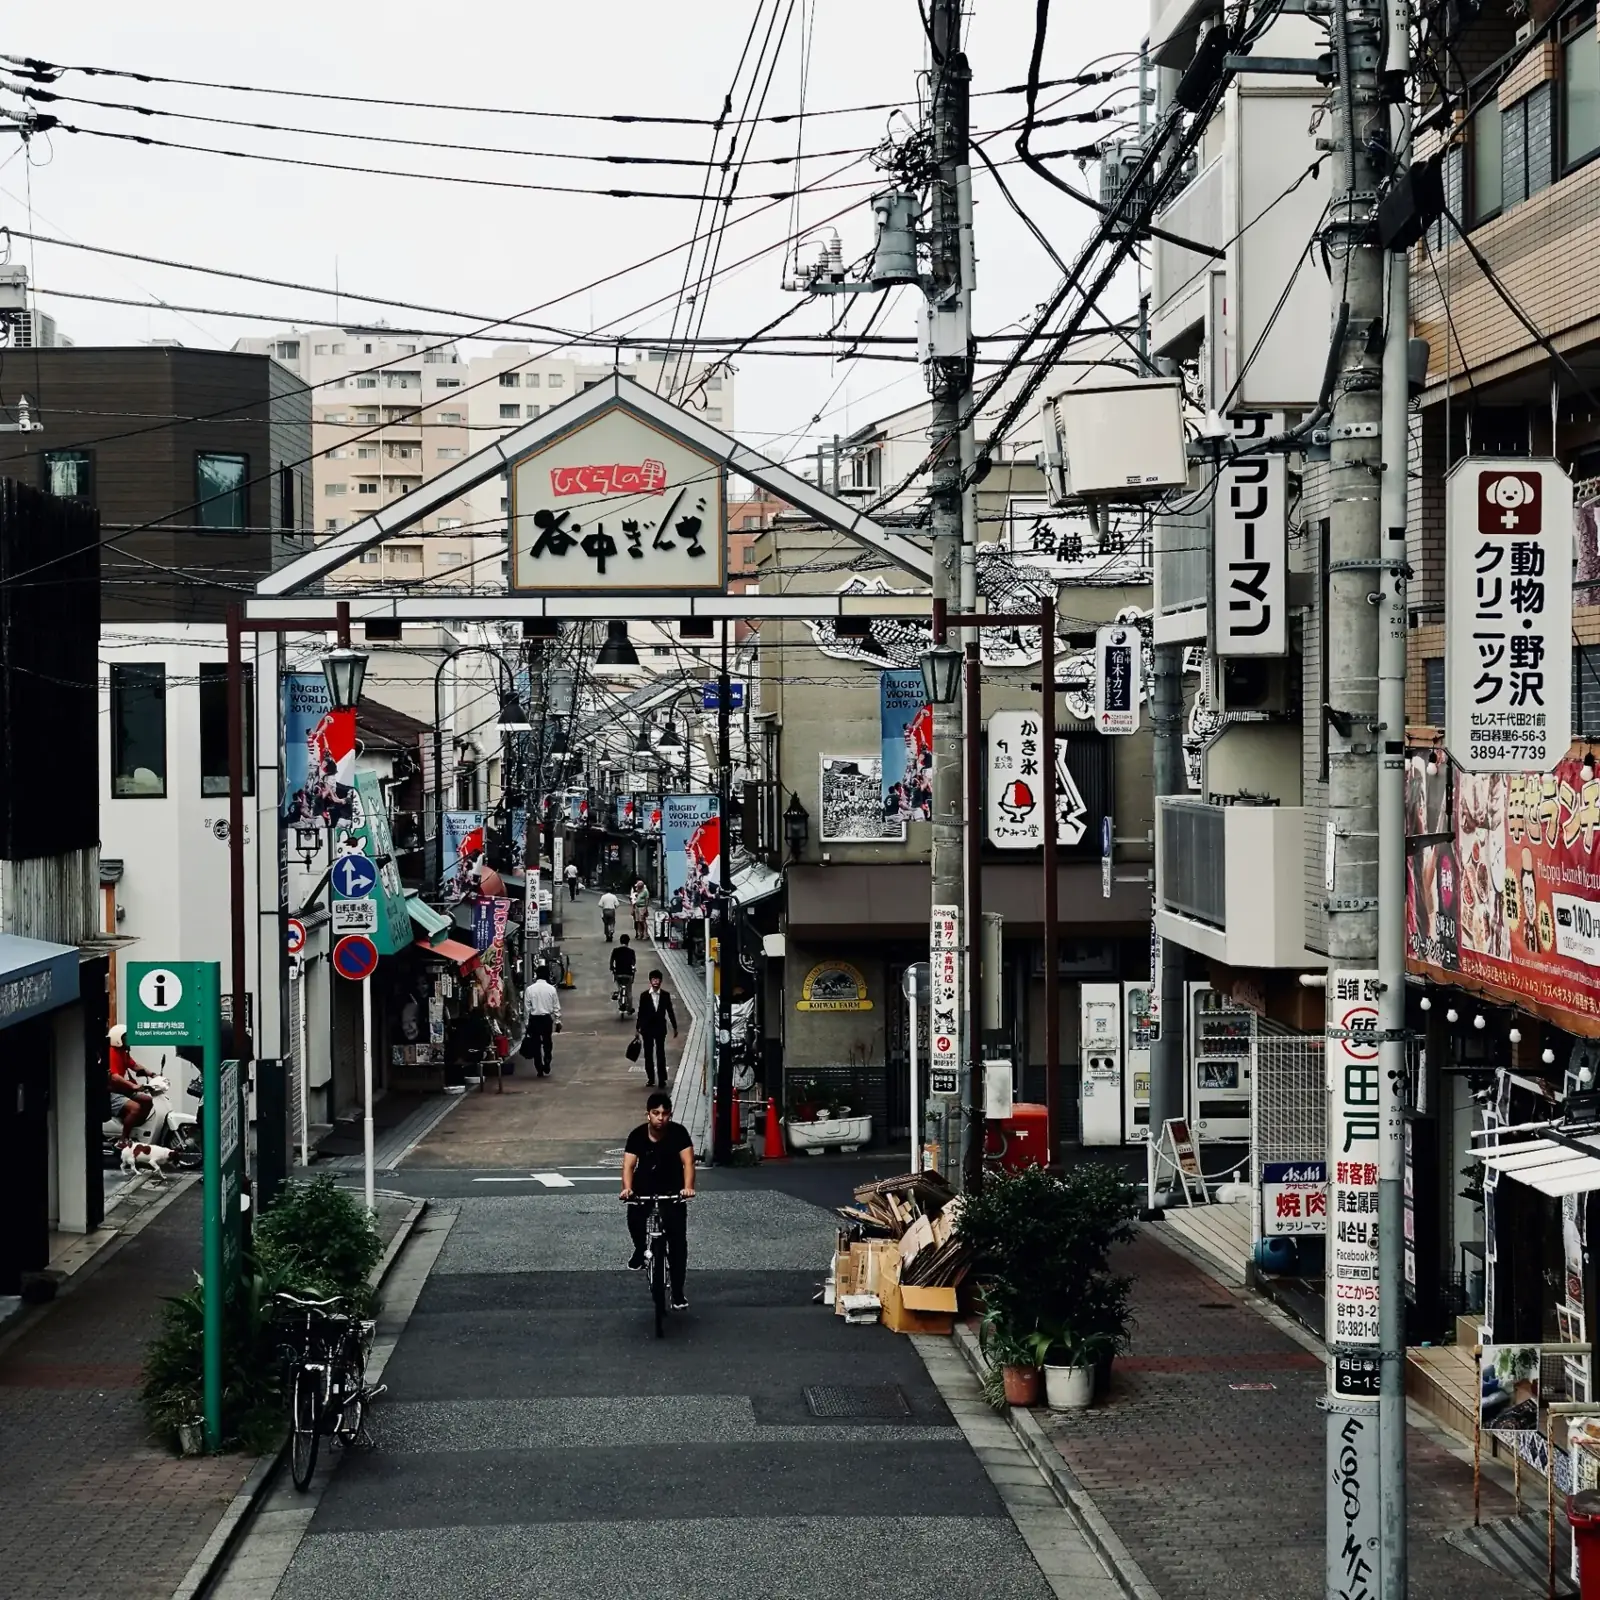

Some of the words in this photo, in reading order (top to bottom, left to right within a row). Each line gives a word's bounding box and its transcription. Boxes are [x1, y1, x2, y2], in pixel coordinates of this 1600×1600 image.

[553, 459, 666, 495] ひぐらしの里
[530, 488, 706, 575] 谷中ぎんざ
[1473, 541, 1505, 705] クリニック
[1510, 541, 1545, 706] 動物・野沢
[886, 680, 921, 689] RUGBY
[1111, 650, 1125, 707] 宿木カフェ
[290, 683, 326, 694] RUGBY
[886, 690, 924, 698] WORLD
[290, 694, 328, 704] WORLD
[886, 700, 910, 709] 2019,
[290, 704, 315, 714] 2019,
[1471, 712, 1546, 727] セレス千代田21前
[1471, 729, 1546, 742] 西日暮里6-56-3
[1020, 720, 1038, 776] かき氷
[1471, 745, 1546, 760] 3894-7739
[668, 804, 697, 812] RUGBY
[668, 812, 699, 820] WORLD
[994, 824, 1039, 838] ひみつ堂
[335, 912, 373, 923] 一方通行
[809, 1001, 837, 1009] KOIWAI
[839, 1001, 860, 1009] FARM
[1343, 1065, 1379, 1153] 田戸
[1282, 1166, 1320, 1182] Asahi
[1337, 1162, 1380, 1185] 新客歓
[1276, 1192, 1327, 1218] 焼肉
[1337, 1303, 1379, 1318] 谷中3-2
